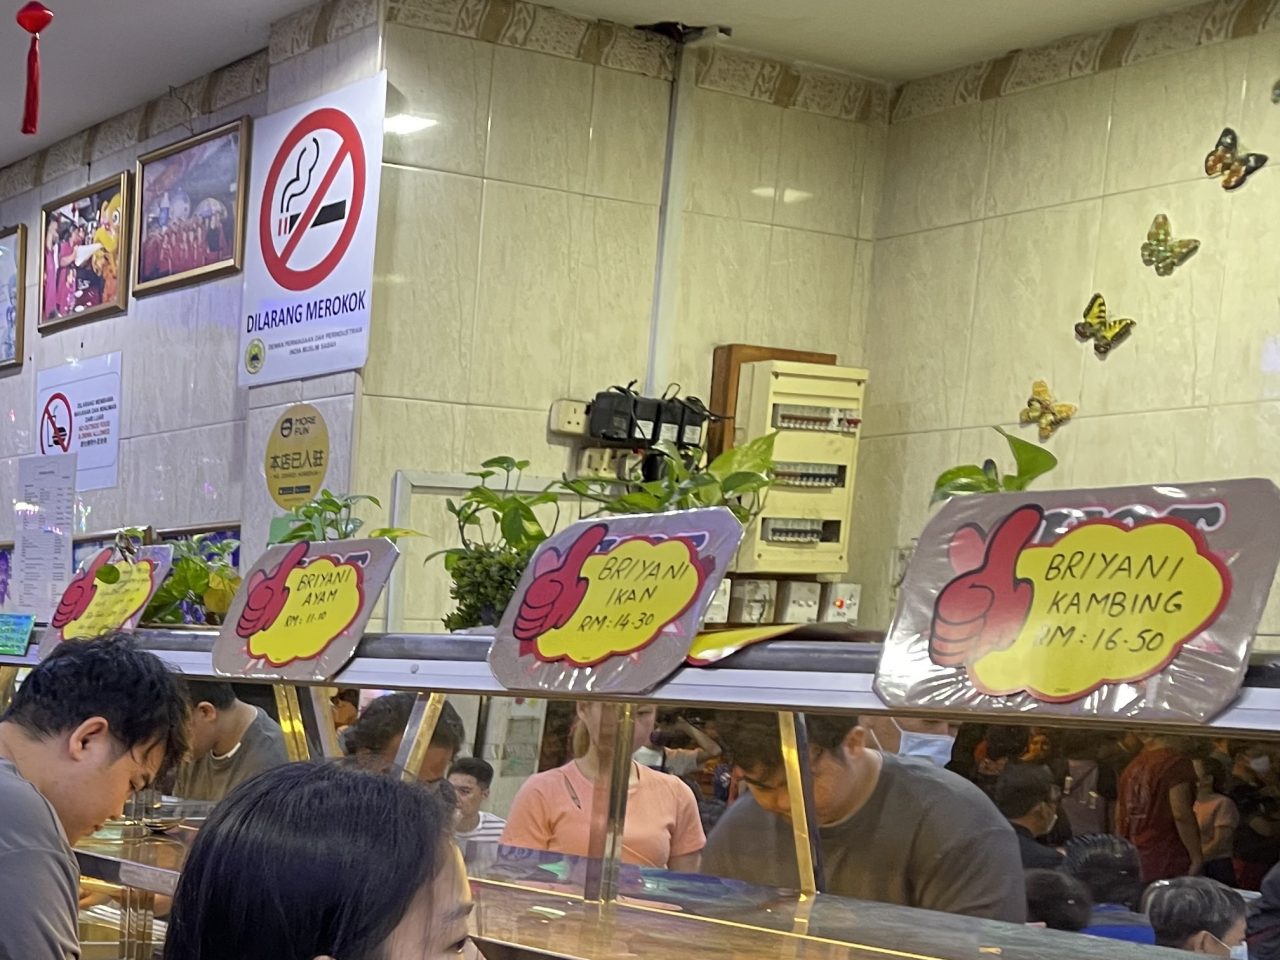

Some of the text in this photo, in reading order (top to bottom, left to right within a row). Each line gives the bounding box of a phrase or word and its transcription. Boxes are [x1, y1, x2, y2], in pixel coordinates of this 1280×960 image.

[247, 290, 366, 333] DILARANG MEROKOK
[294, 426, 310, 436] FUN
[295, 416, 317, 425] MORE
[597, 556, 689, 580] BRIYANI
[1045, 550, 1184, 582] BRIYANI
[297, 568, 352, 591] BRIYANI
[302, 588, 338, 606] AYAM
[606, 585, 658, 607] IKAN
[1047, 590, 1184, 618] KAMBING
